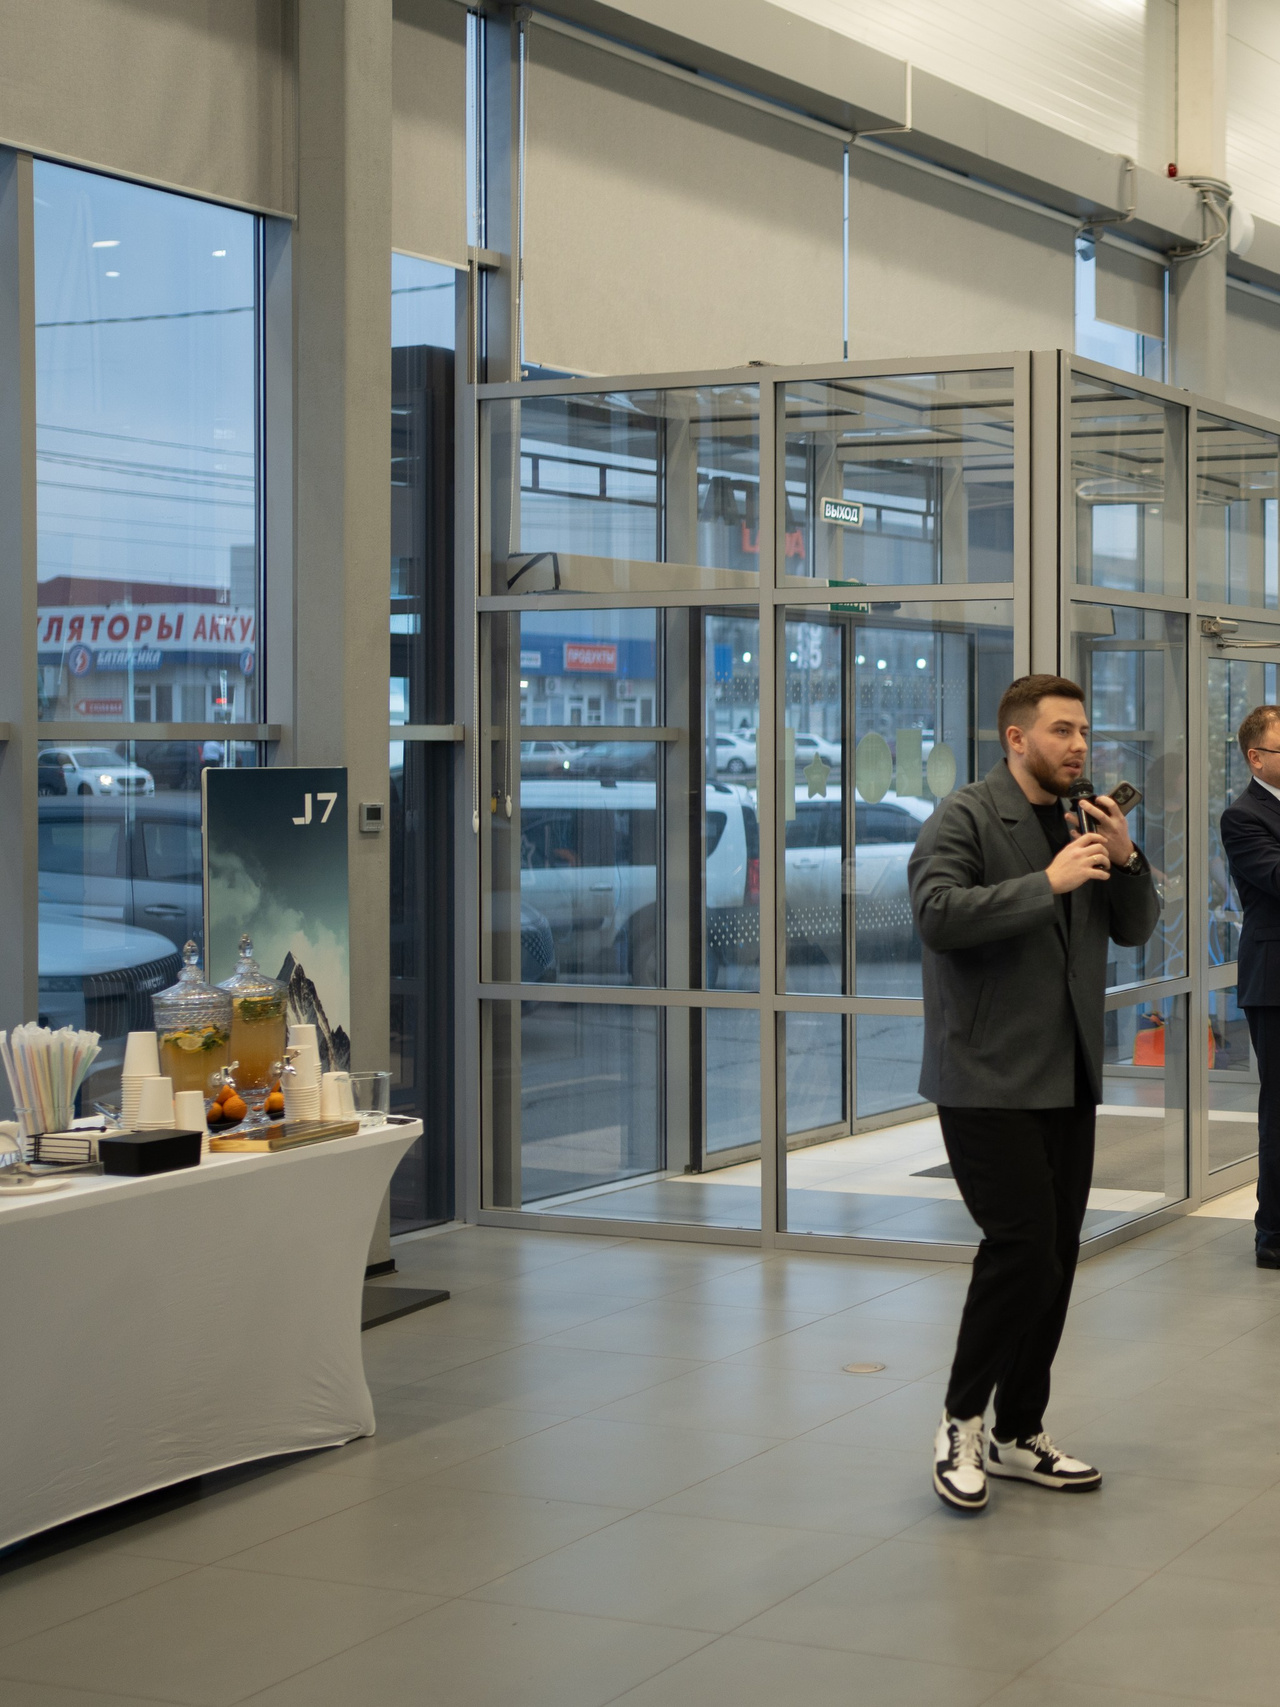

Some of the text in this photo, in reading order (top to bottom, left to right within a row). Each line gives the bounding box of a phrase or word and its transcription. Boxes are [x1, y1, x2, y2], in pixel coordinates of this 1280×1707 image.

[825, 503, 859, 522] ВЫХОД
[193, 612, 256, 643] АККУ
[292, 792, 338, 826] J7
